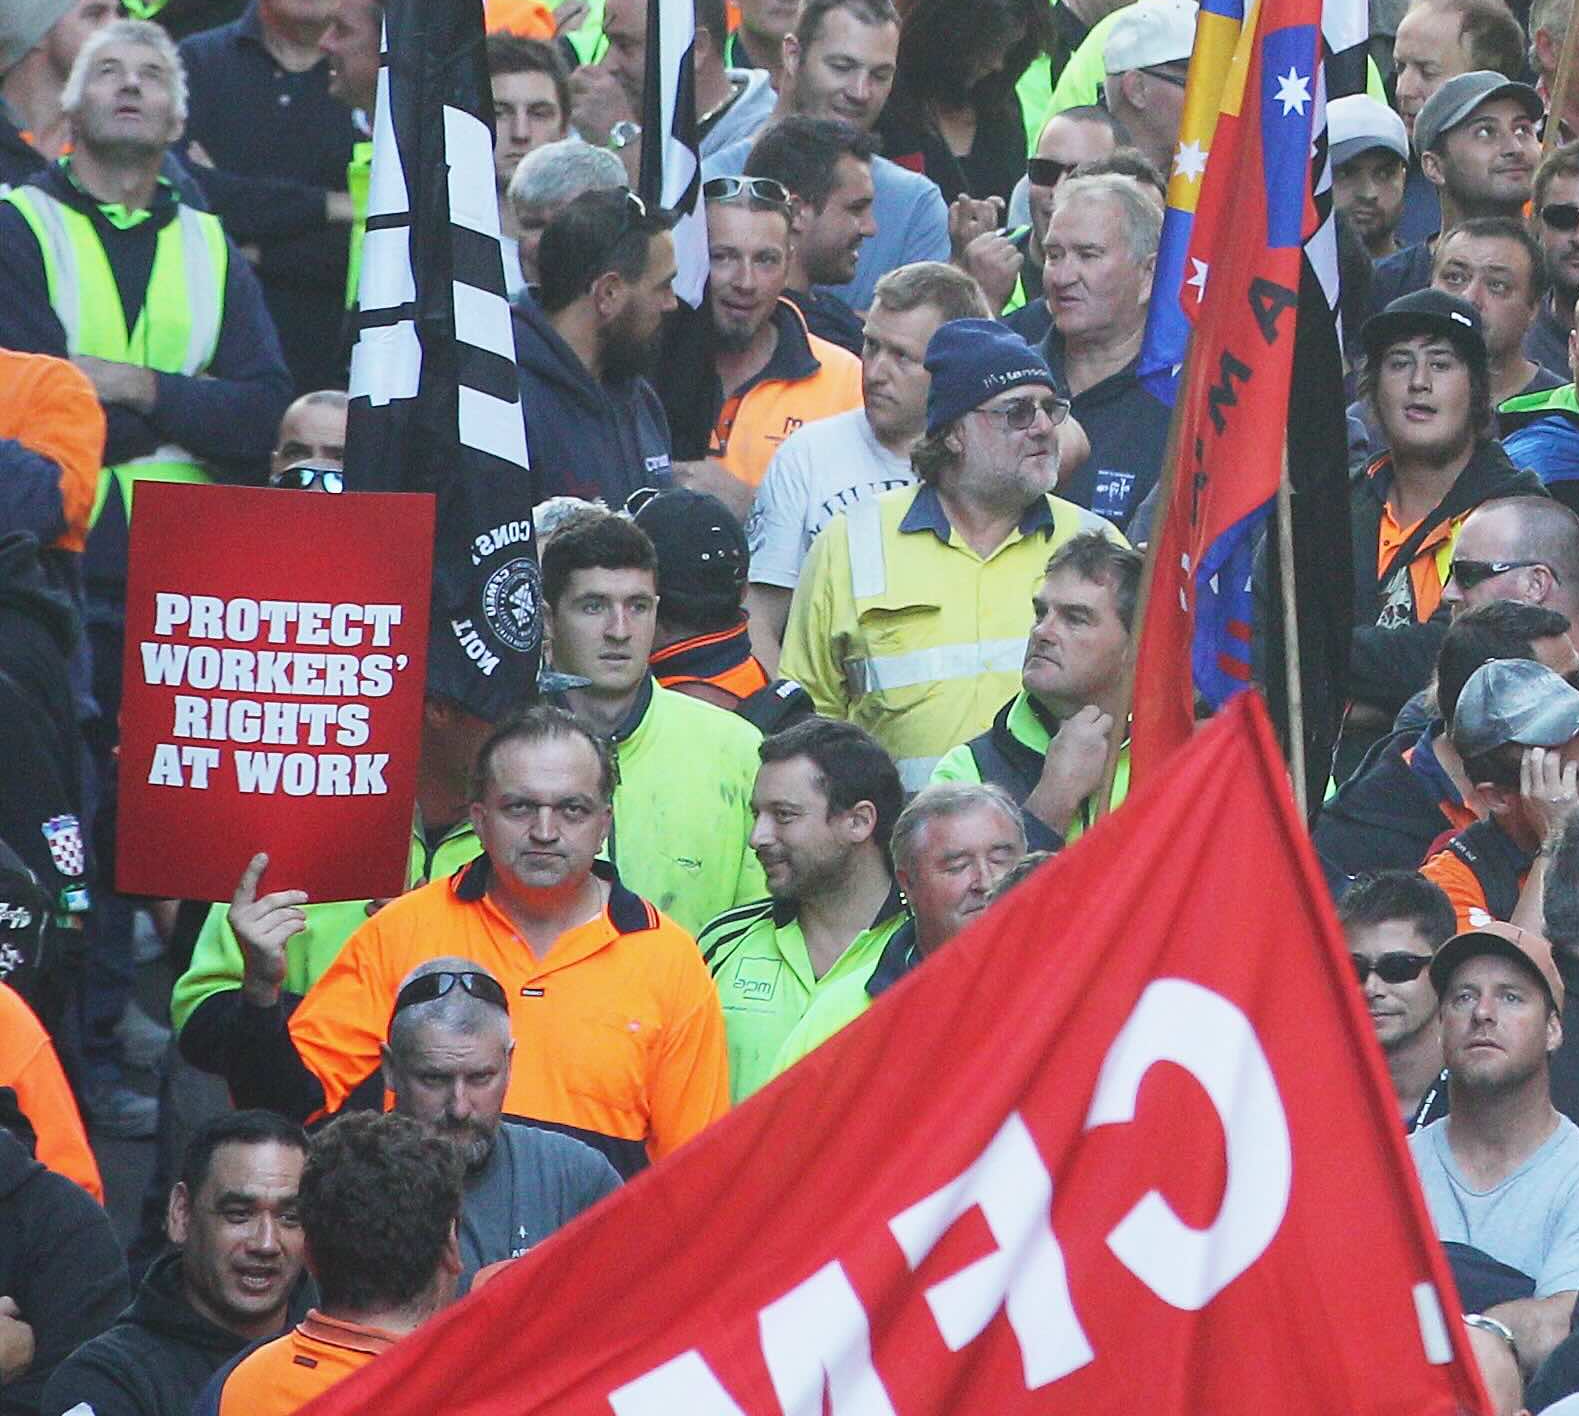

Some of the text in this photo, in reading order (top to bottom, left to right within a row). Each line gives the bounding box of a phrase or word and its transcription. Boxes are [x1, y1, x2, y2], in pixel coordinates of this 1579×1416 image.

[154, 592, 402, 647] PROTECT
[140, 642, 409, 697] WORKERS'
[173, 694, 370, 747] RIGHTS
[148, 743, 389, 796] AT WORK
